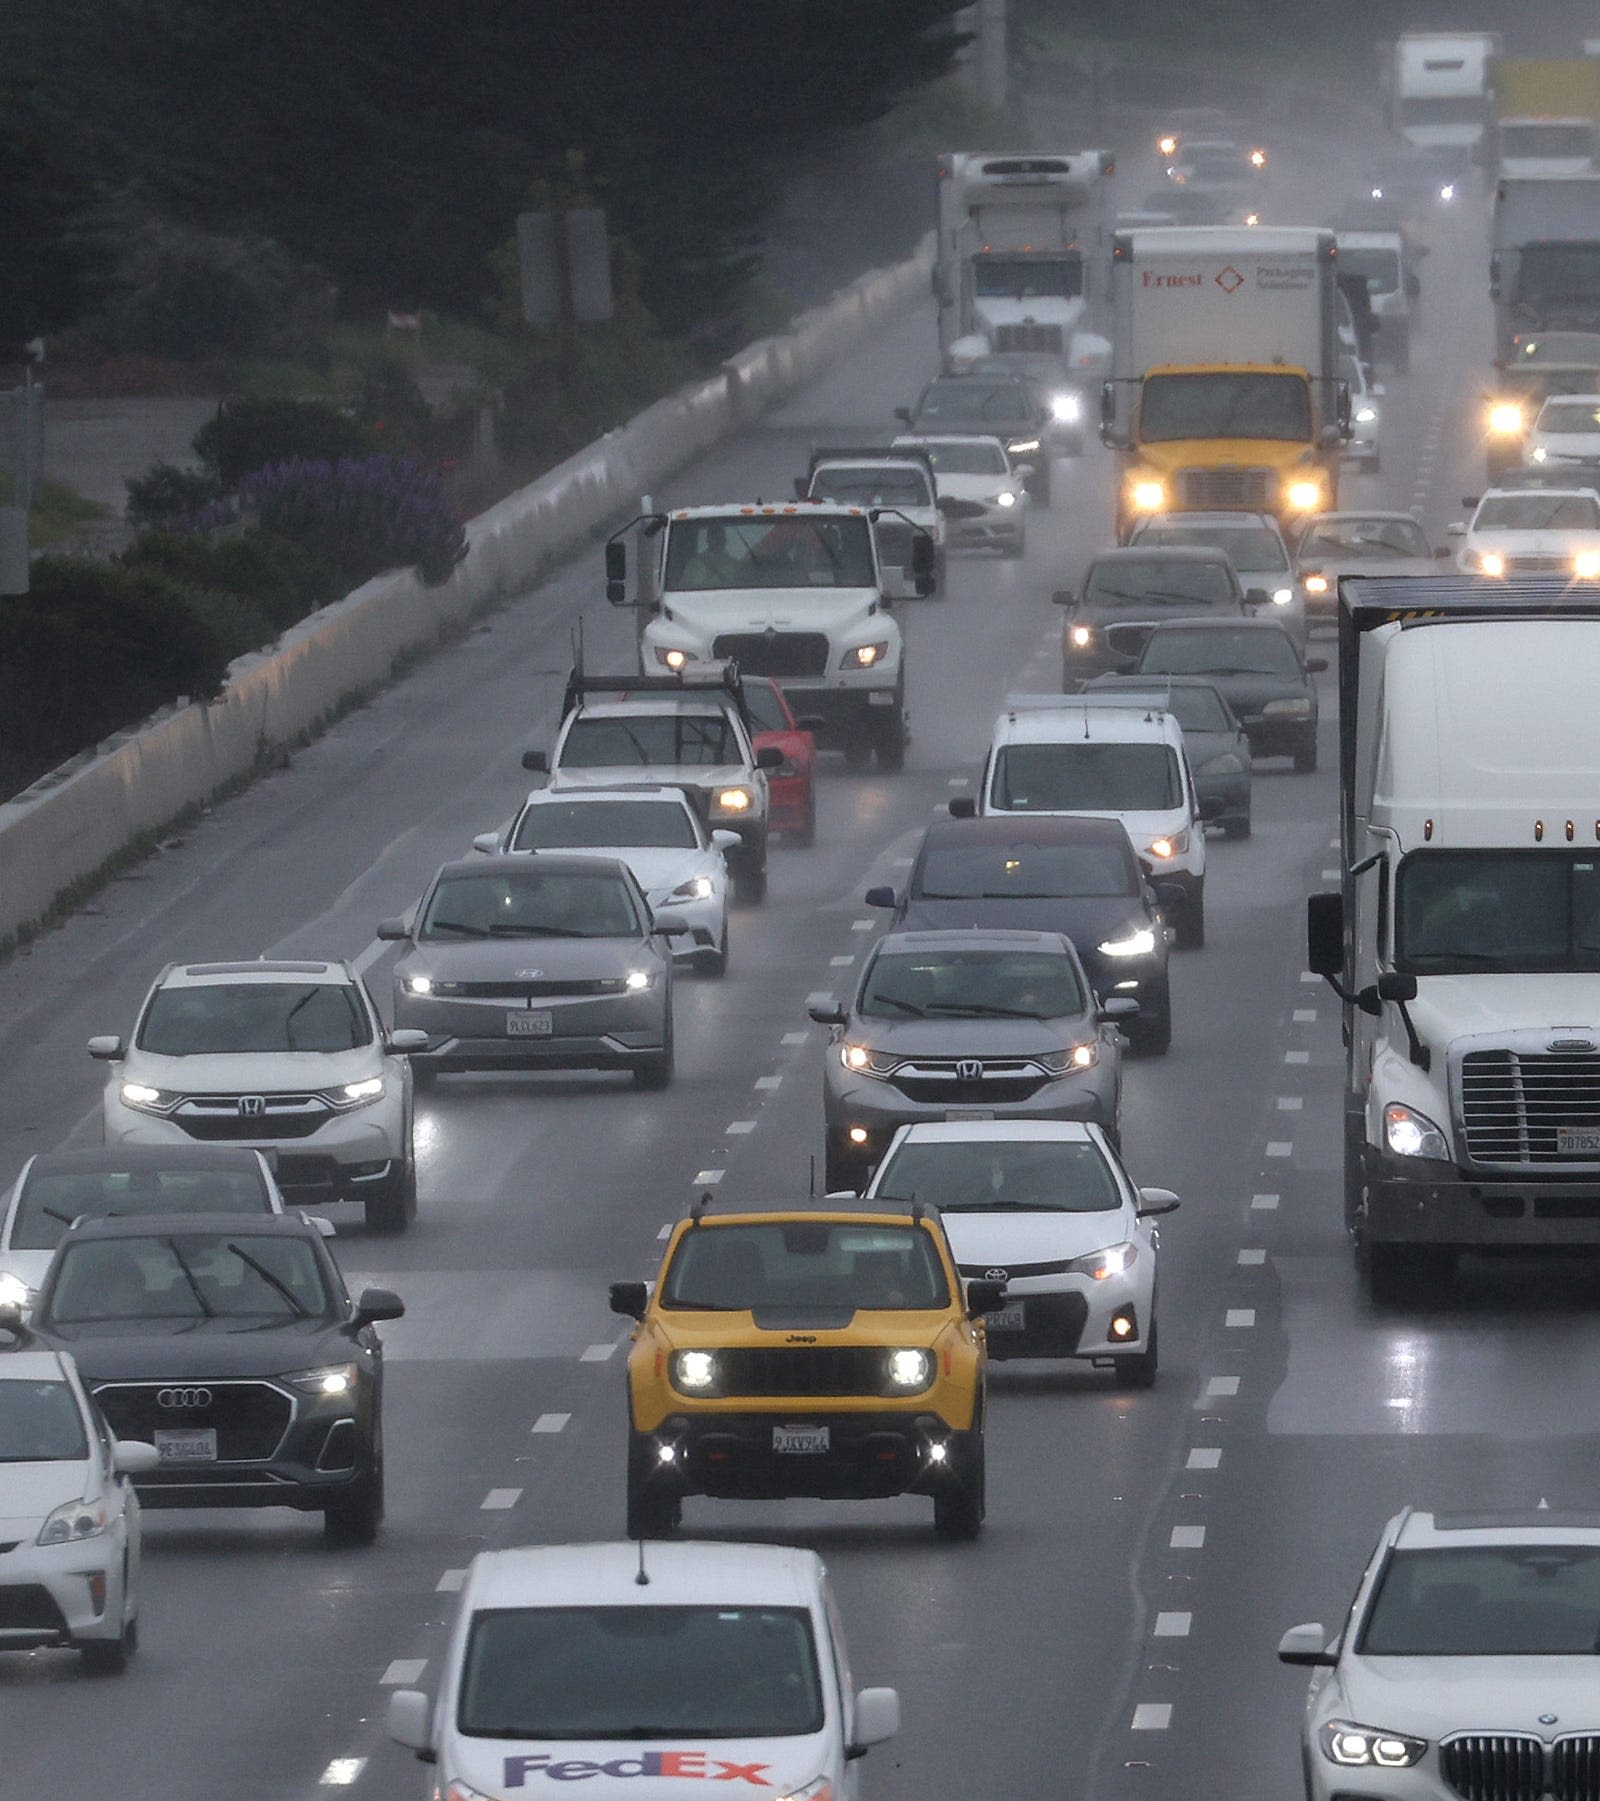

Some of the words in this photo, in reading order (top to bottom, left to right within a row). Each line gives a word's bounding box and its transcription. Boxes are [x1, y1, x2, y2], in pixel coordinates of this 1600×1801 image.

[1142, 271, 1202, 288] Ernest
[785, 1335, 817, 1345] Jeep
[504, 1751, 772, 1788] FedEx
